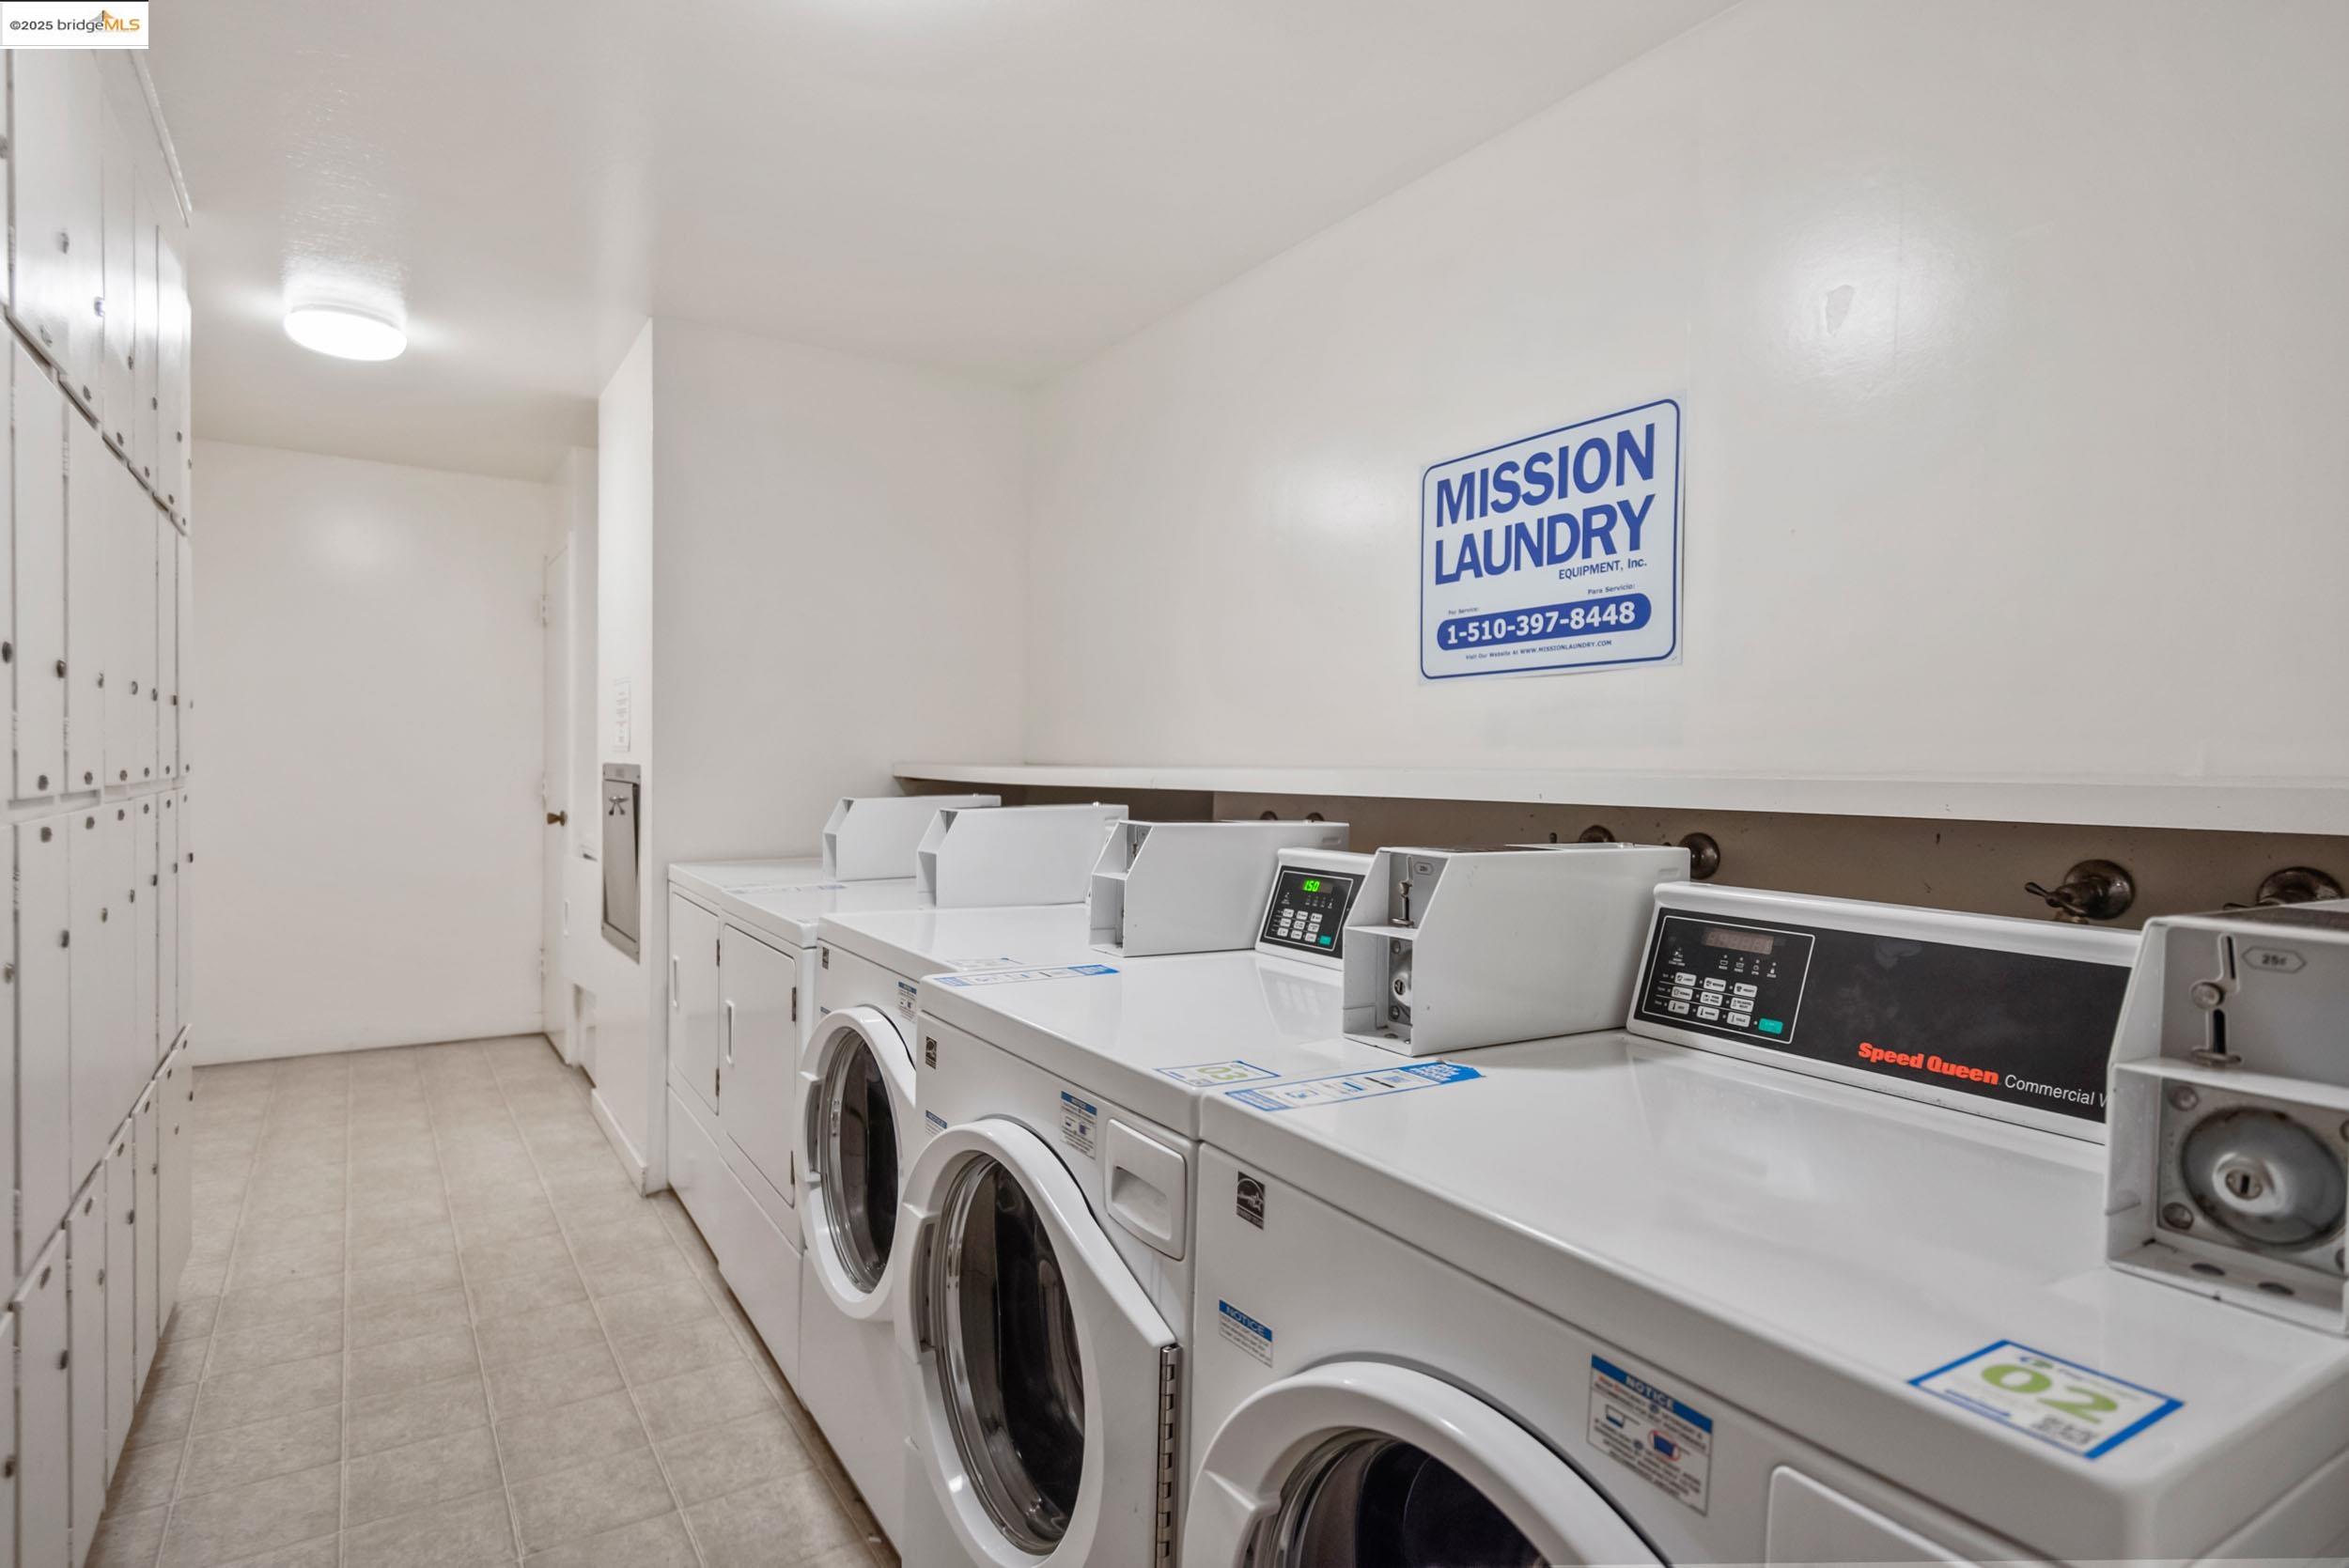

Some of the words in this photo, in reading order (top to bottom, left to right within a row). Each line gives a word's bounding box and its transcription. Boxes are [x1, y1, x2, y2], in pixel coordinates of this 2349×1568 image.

[1436, 423, 1656, 528] MISSION
[1435, 493, 1657, 585] LAUNDRY
[1558, 560, 1624, 580] EQUIPMENT,
[1626, 557, 1647, 569] Inc.
[1587, 586, 1603, 596] Para
[1447, 600, 1636, 645] 1-510-397-8448
[1519, 640, 1612, 656] WWW.MISSIONLAUNDRY.COM
[1858, 1042, 1924, 1069] Speed
[1926, 1055, 1999, 1085] Queen
[2004, 1074, 2094, 1106] Commercial
[1226, 1305, 1265, 1338] NOTICE
[1626, 1374, 1673, 1409] NOTICE
[1981, 1364, 2119, 1424] 02
